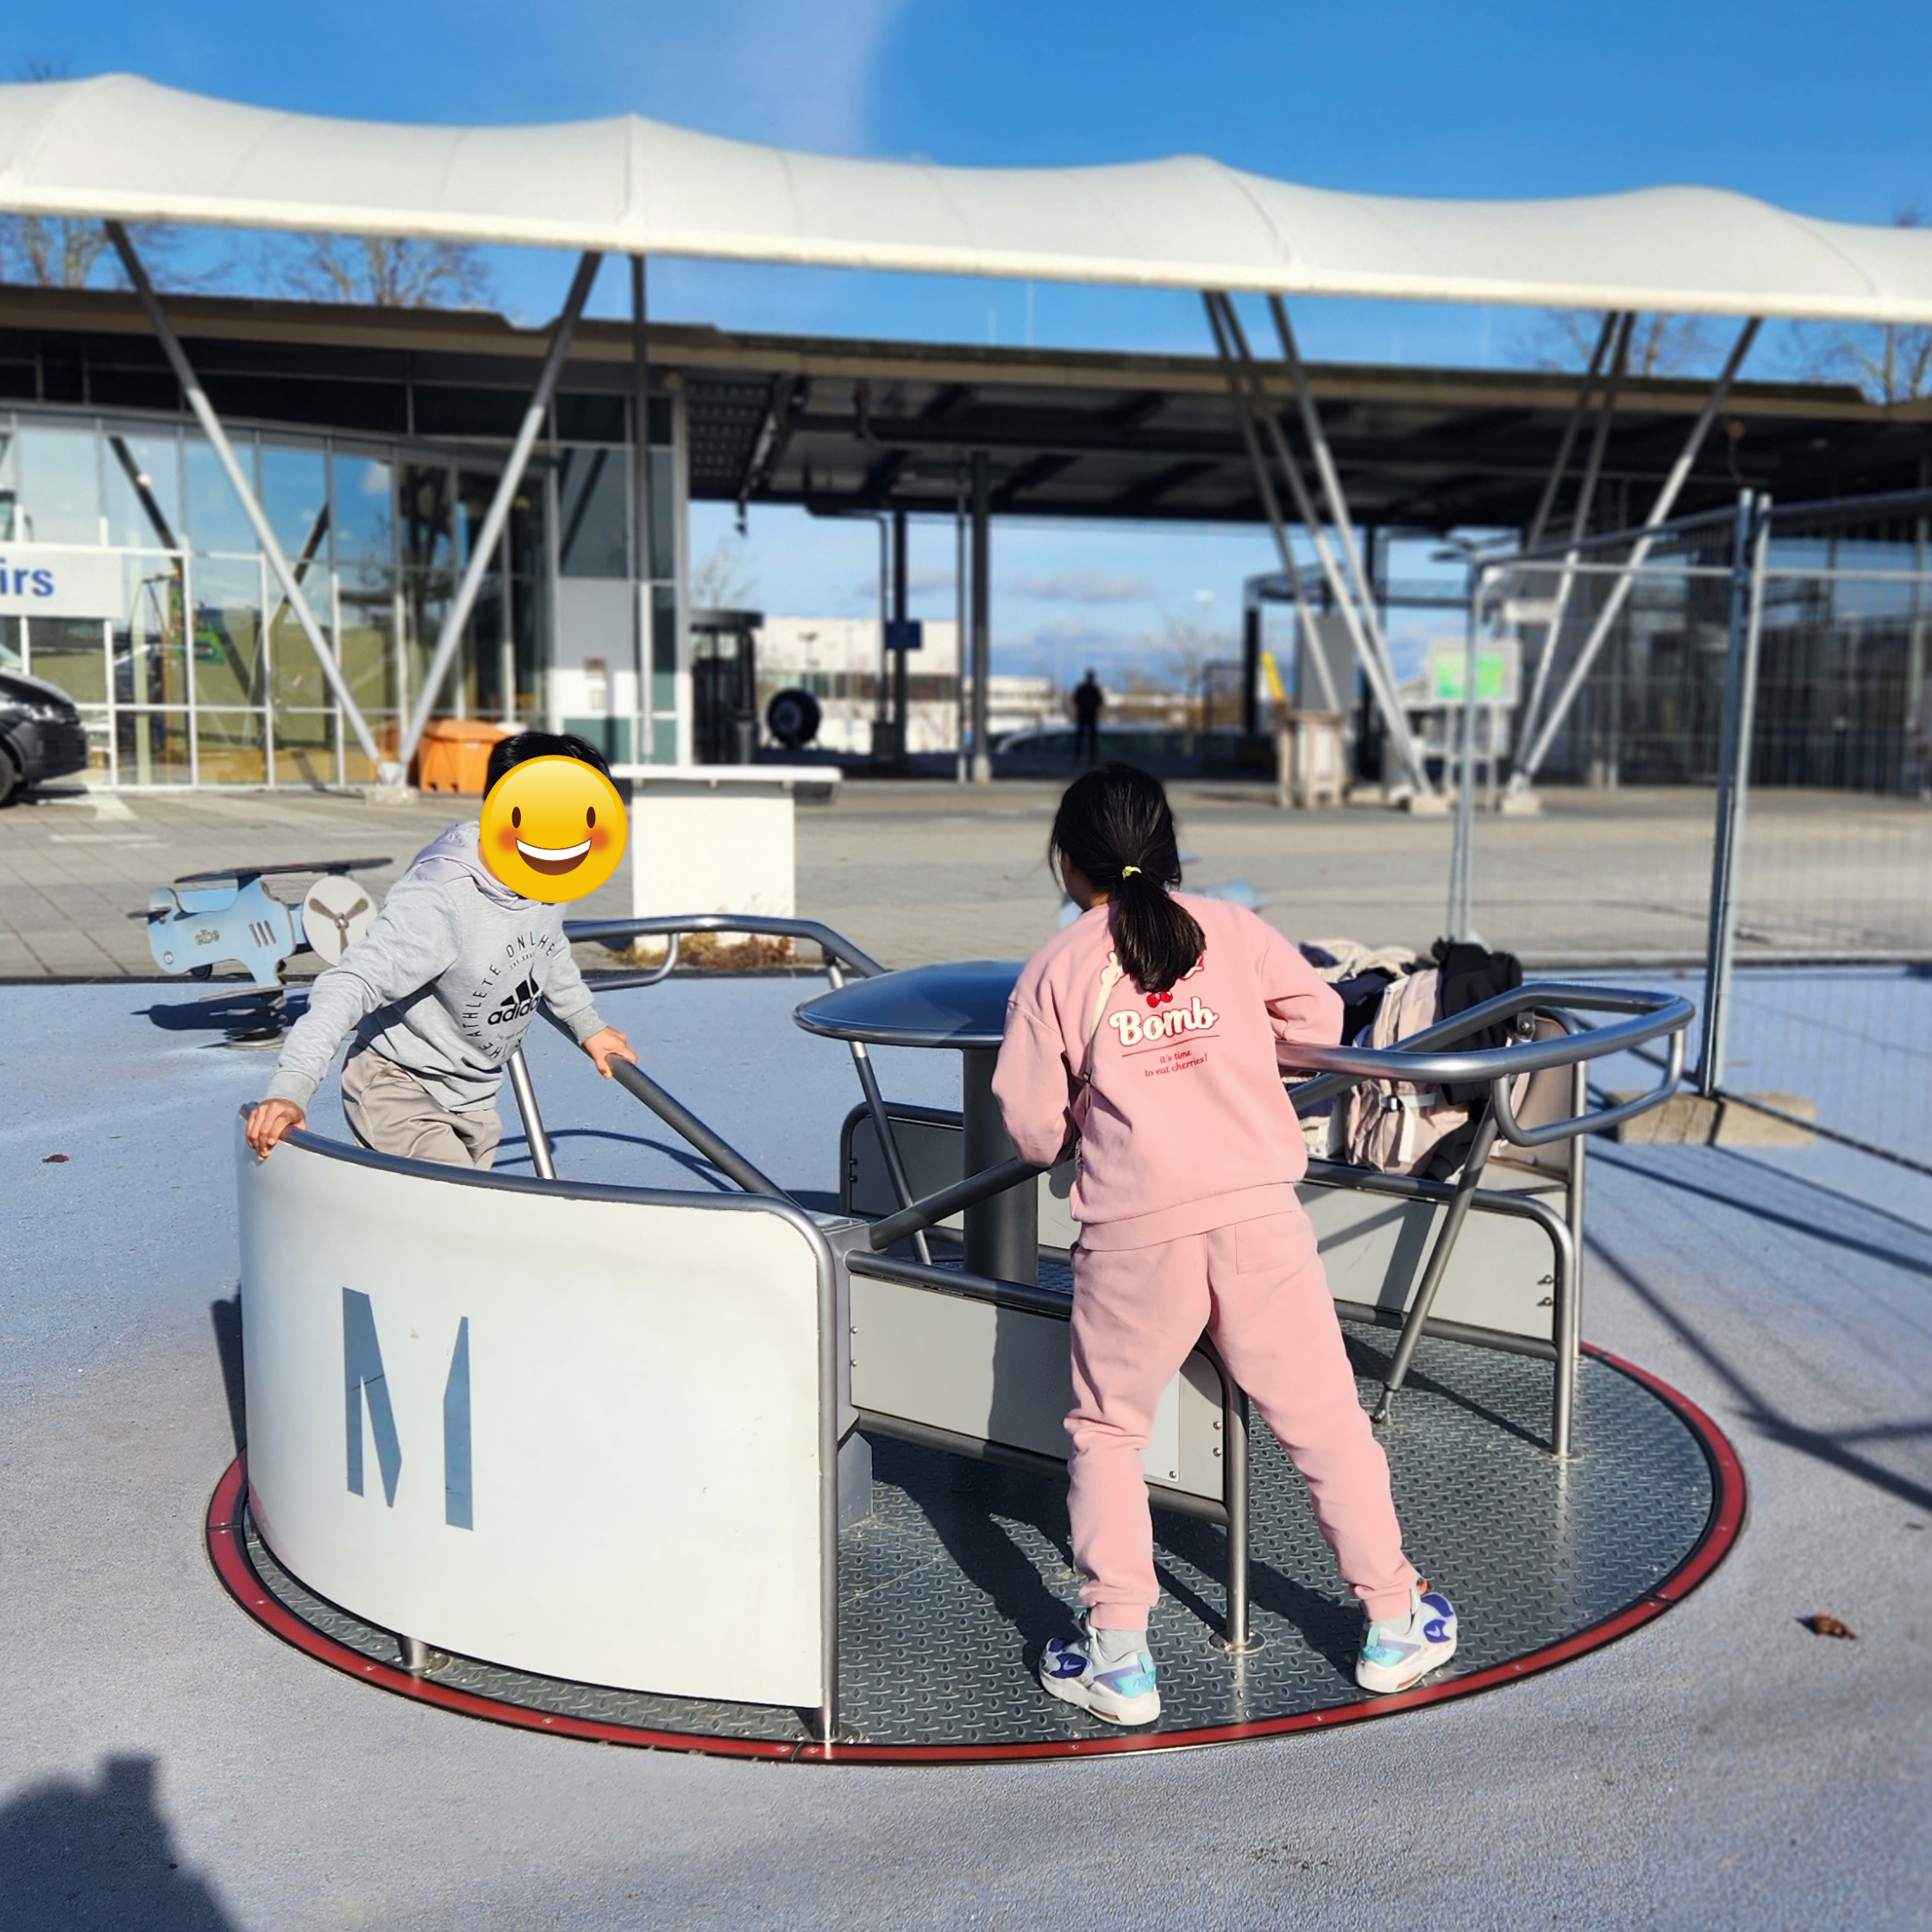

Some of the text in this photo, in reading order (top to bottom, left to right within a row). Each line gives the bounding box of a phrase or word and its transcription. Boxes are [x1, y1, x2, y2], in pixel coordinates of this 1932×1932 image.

[487, 996, 540, 1026] adida
[1108, 996, 1220, 1047] Bomb
[1174, 1050, 1191, 1060] time
[1156, 1066, 1170, 1075] eat
